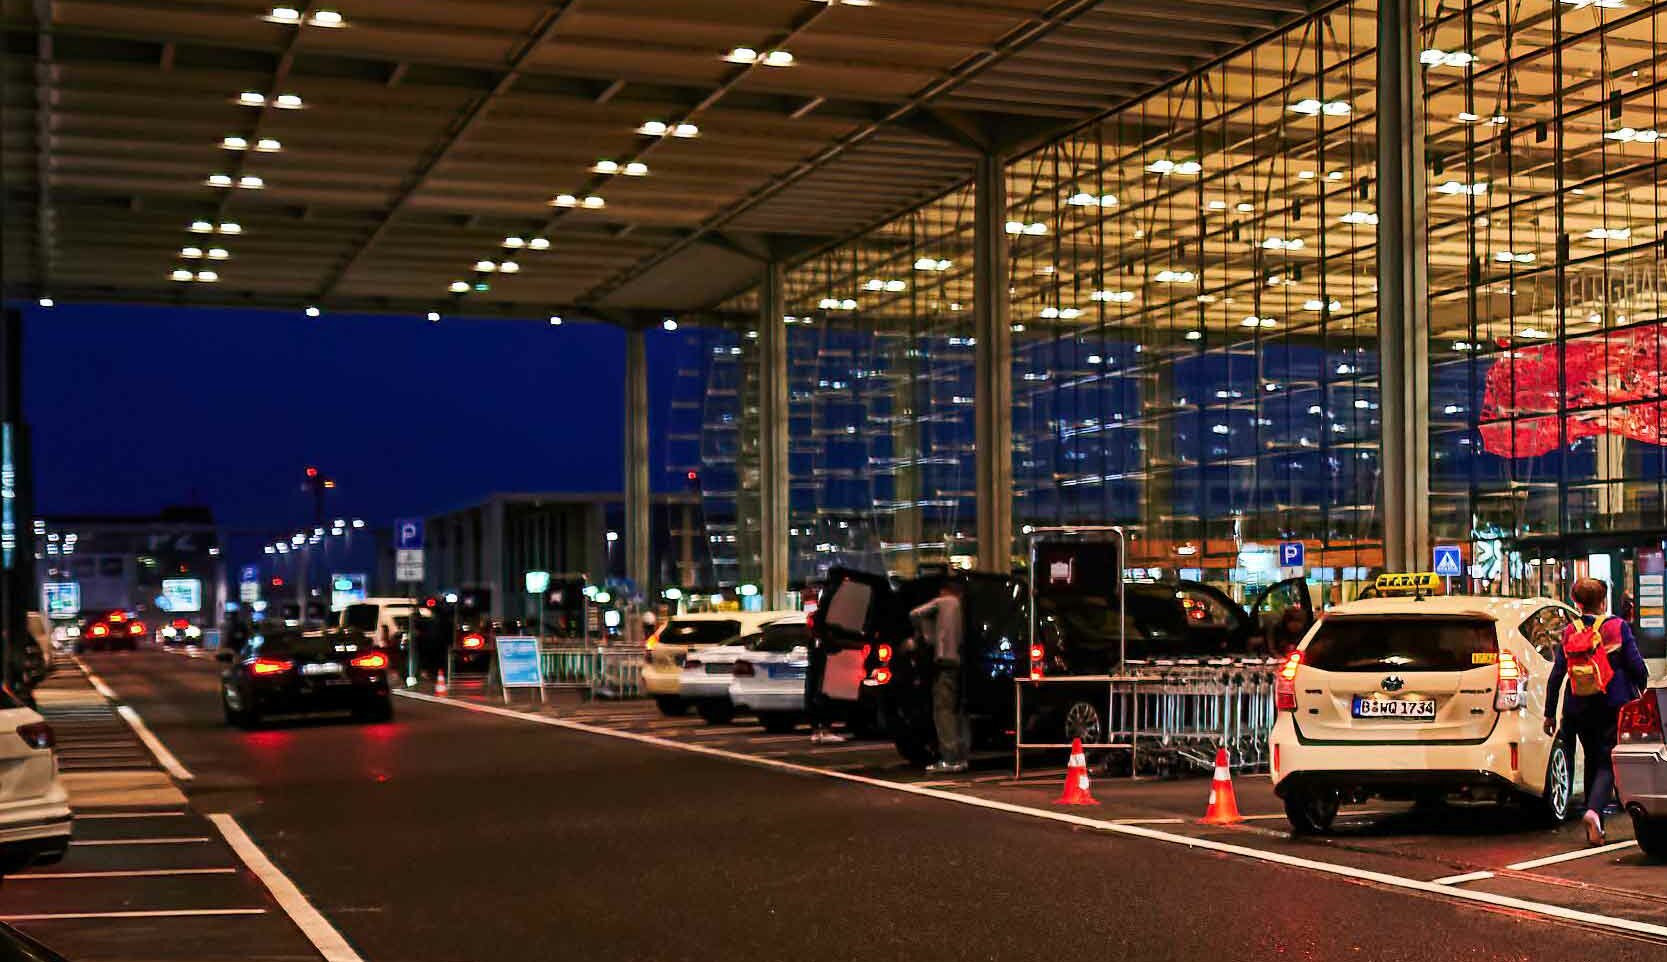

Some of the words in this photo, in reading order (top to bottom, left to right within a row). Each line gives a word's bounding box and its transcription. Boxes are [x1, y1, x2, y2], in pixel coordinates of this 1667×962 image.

[402, 523, 417, 545] P
[1284, 546, 1298, 564] P
[1401, 702, 1433, 715] 1734
